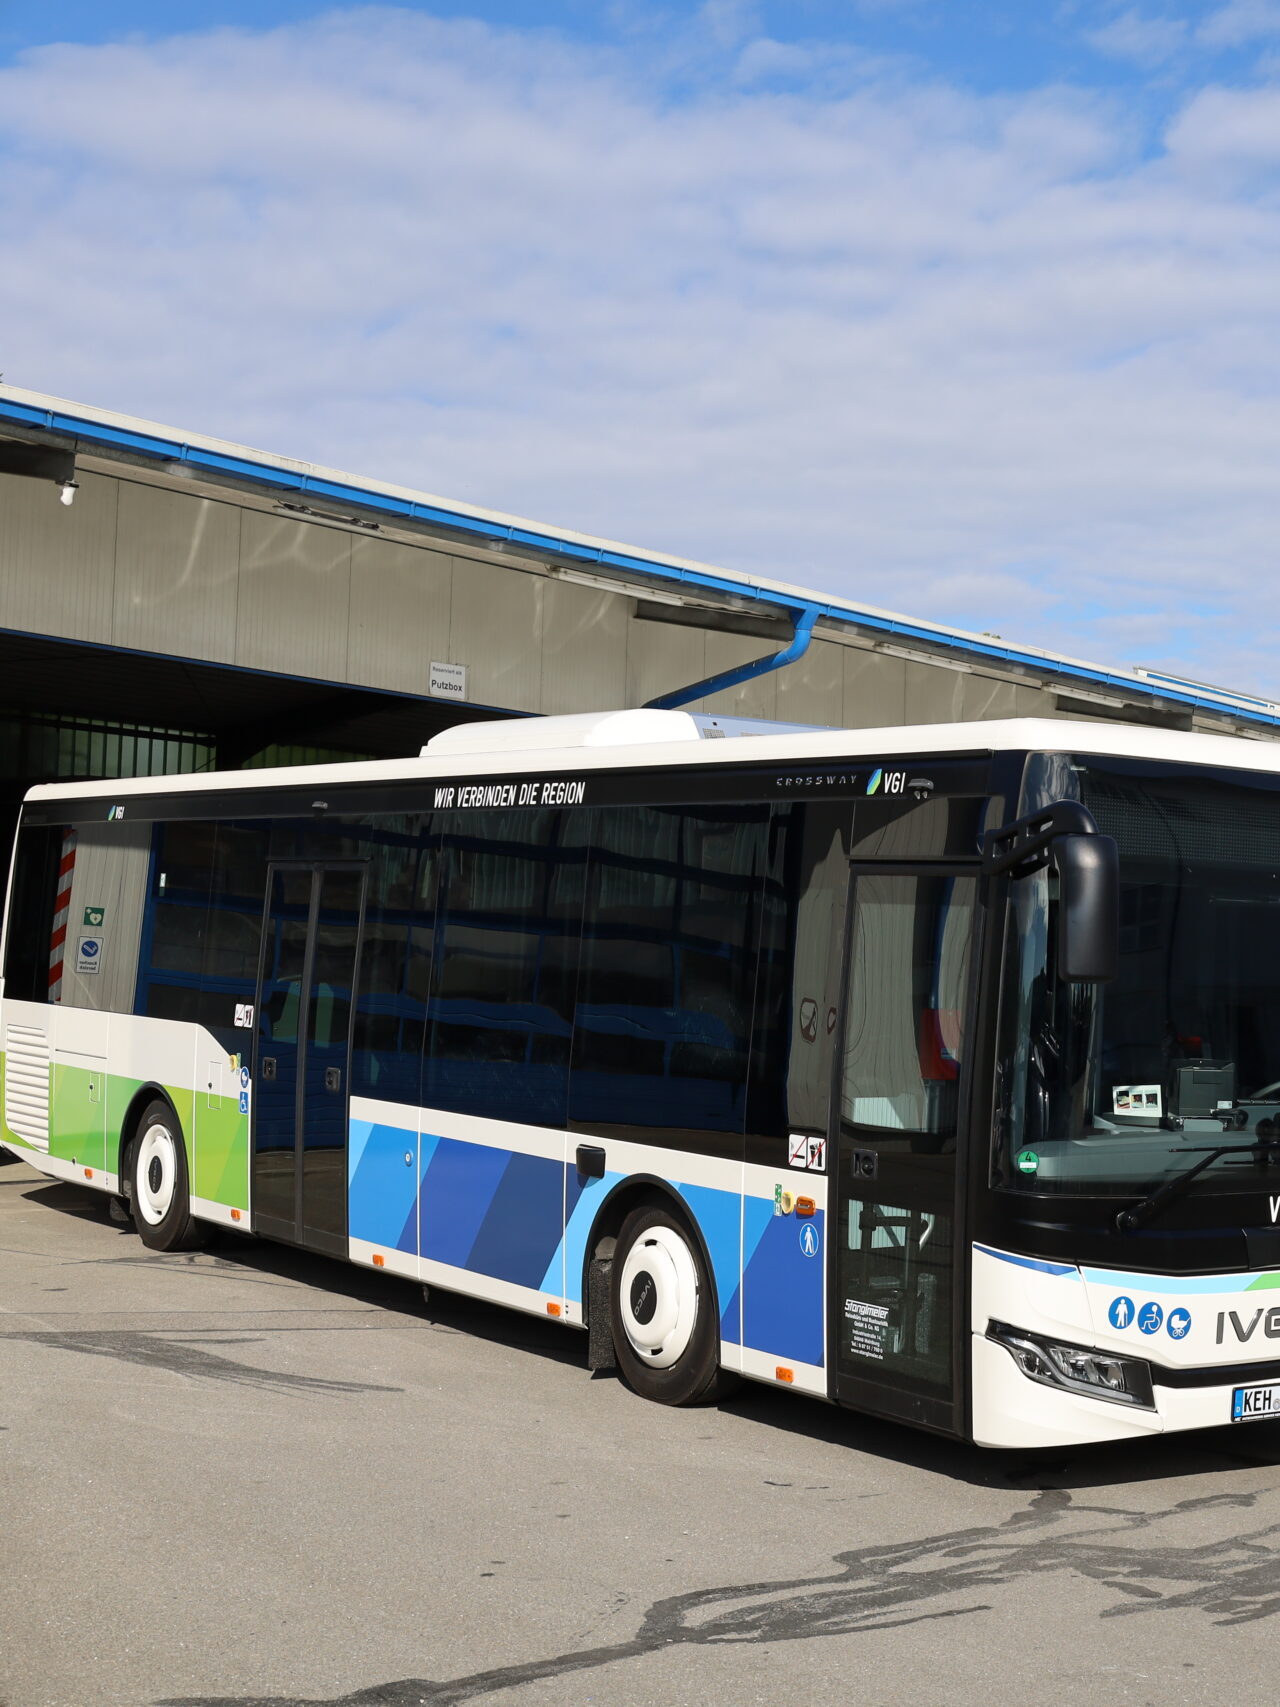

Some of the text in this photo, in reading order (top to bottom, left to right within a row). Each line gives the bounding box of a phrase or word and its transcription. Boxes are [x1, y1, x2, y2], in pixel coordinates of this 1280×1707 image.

[431, 679, 463, 692] Putzbox
[776, 775, 857, 786] CROSSWAY
[884, 772, 906, 794] VGI
[434, 782, 586, 808] WIR VERBINDEN DIE REGION
[115, 806, 125, 819] VGI
[1025, 1152, 1032, 1162] 4
[634, 1280, 651, 1316] IVECO
[1244, 1389, 1272, 1412] KEH
